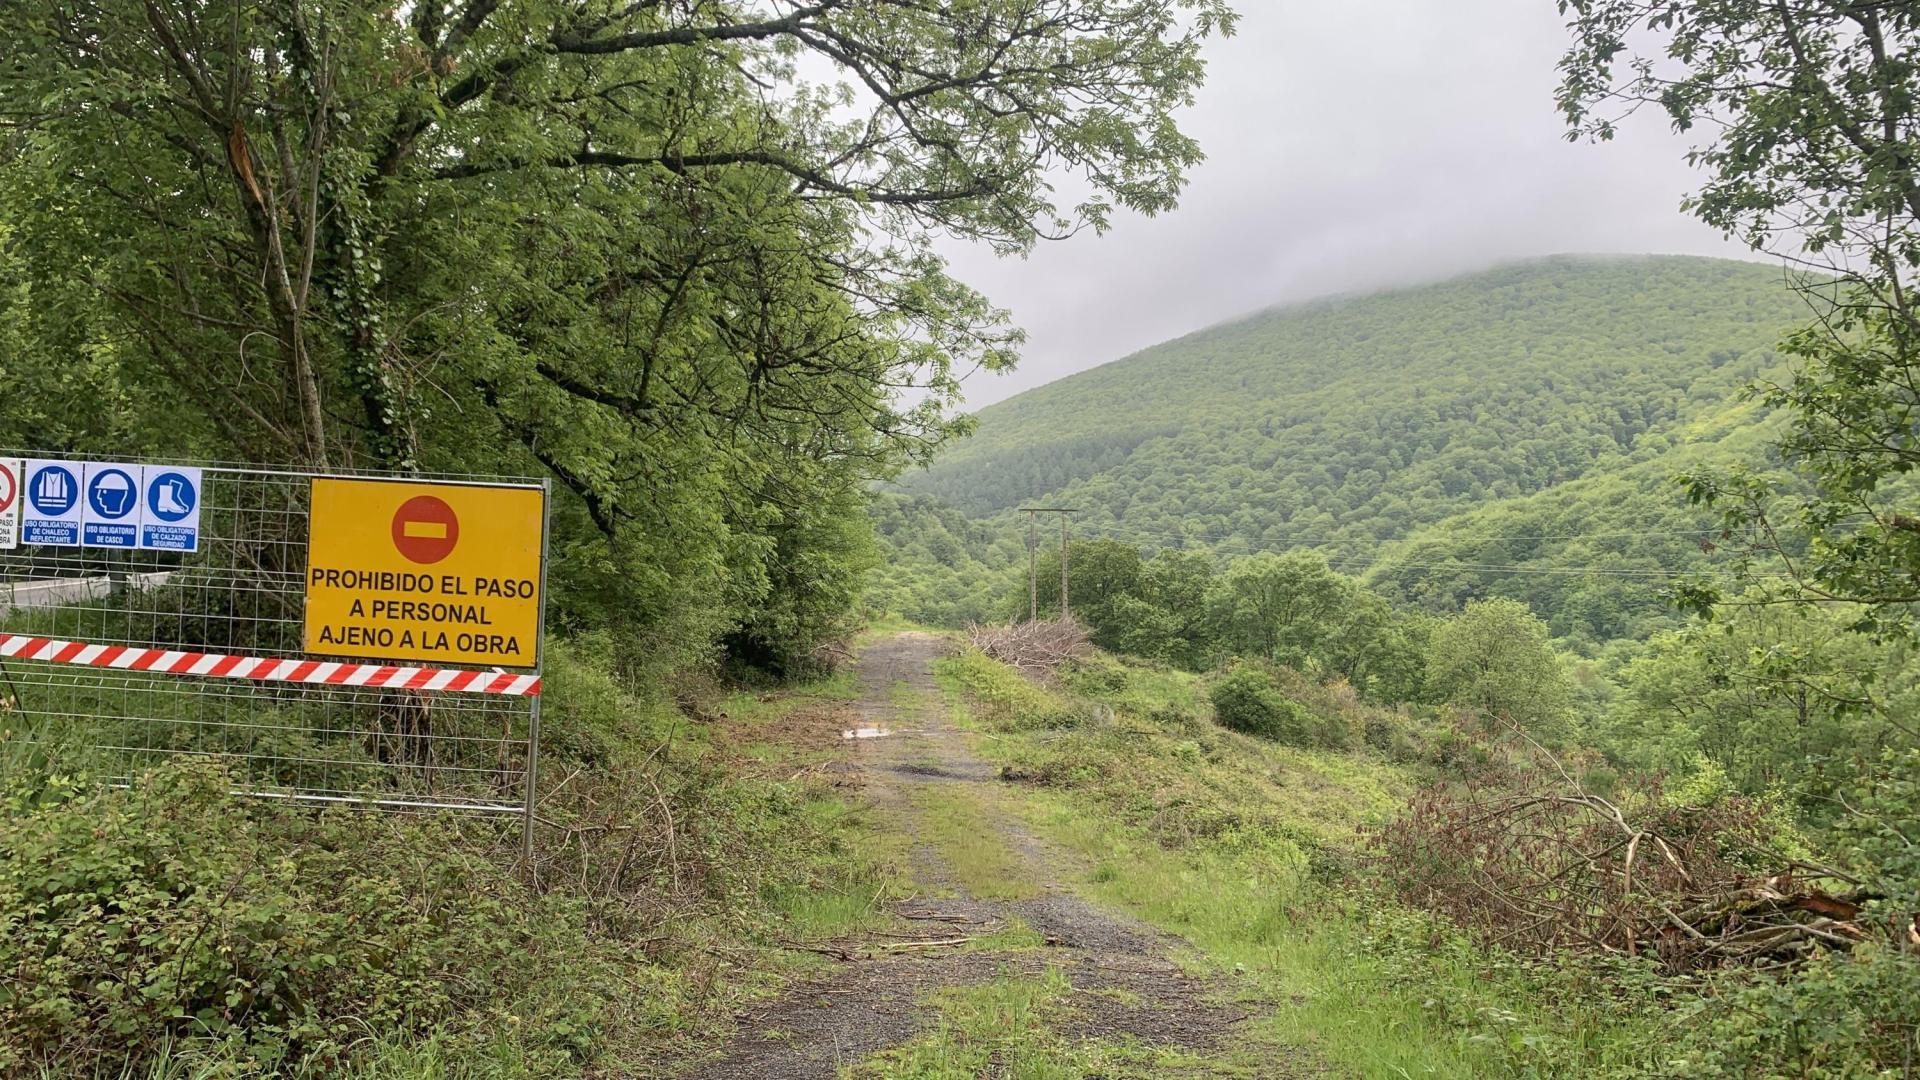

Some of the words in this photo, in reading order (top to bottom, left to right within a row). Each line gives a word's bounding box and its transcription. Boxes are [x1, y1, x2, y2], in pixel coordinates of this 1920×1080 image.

[99, 526, 134, 535] OBLIGATORIO
[157, 526, 194, 535] OBLIGATORIO
[30, 535, 71, 543] REFLECTANTE
[152, 540, 184, 548] SEGURIDAD
[311, 568, 434, 593] PROHIBIDO
[441, 576, 468, 596] EL
[475, 578, 534, 600] PASO
[349, 599, 365, 618] A
[372, 600, 492, 625] PERSONAL
[319, 625, 394, 648] AJENO
[400, 630, 414, 648] A
[422, 631, 449, 651] LA
[456, 633, 520, 655] OBRA
